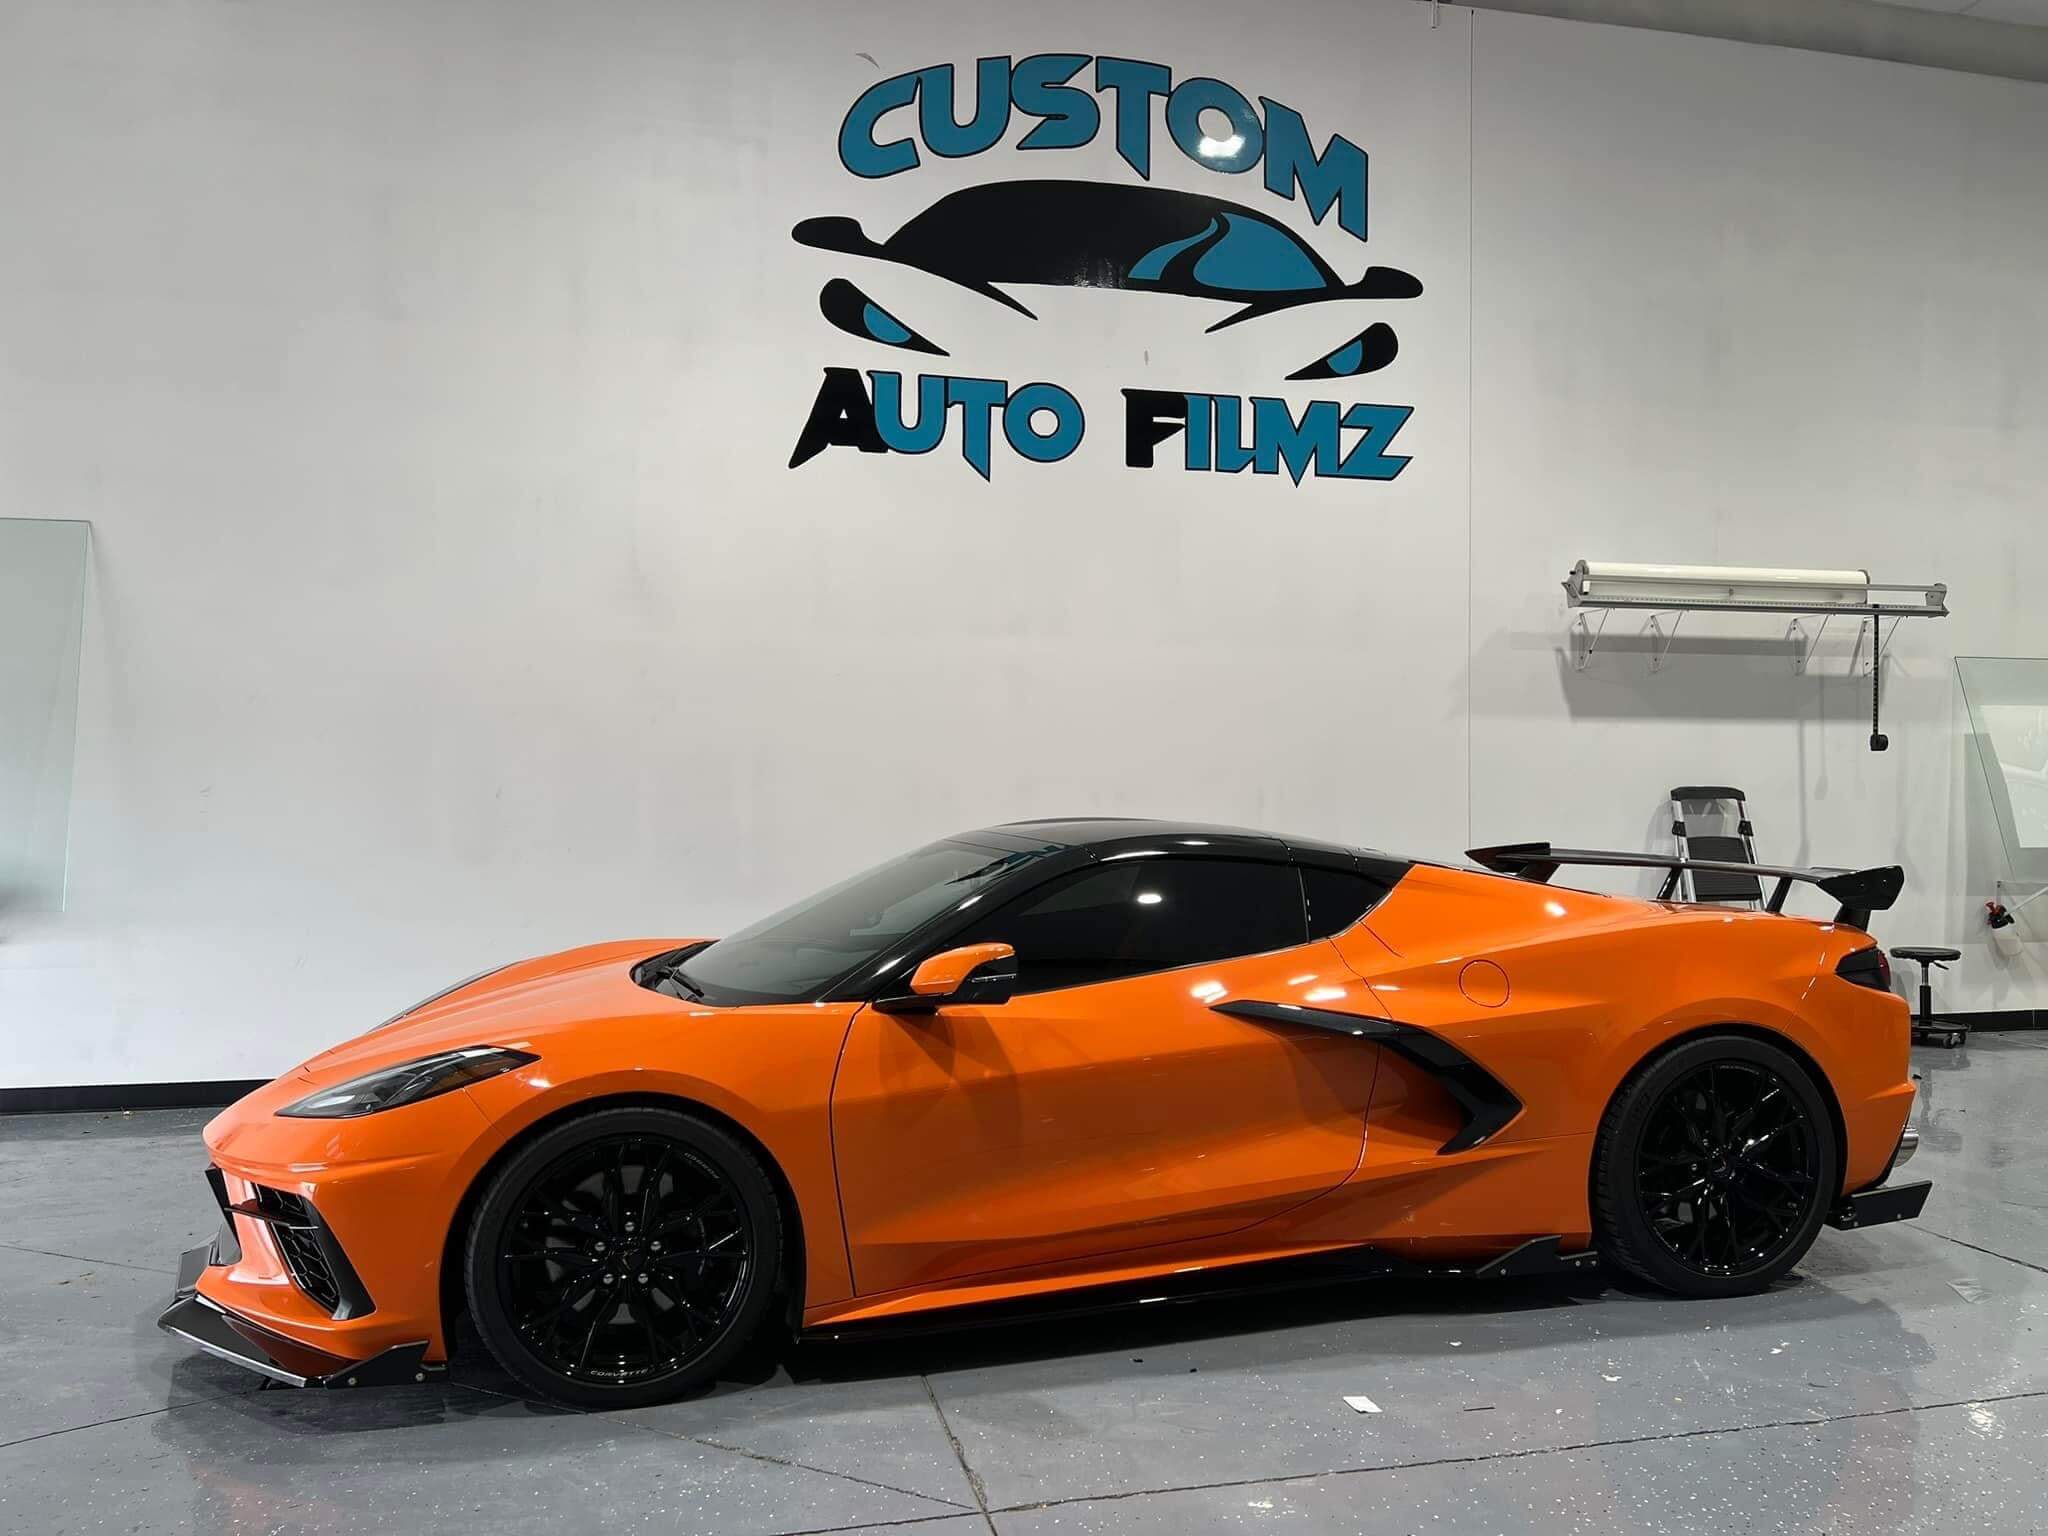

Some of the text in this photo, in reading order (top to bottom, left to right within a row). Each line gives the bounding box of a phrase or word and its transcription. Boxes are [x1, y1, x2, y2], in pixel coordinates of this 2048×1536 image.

[838, 53, 1368, 242] CUSTOM
[788, 367, 1415, 486] AUTO FILMZ
